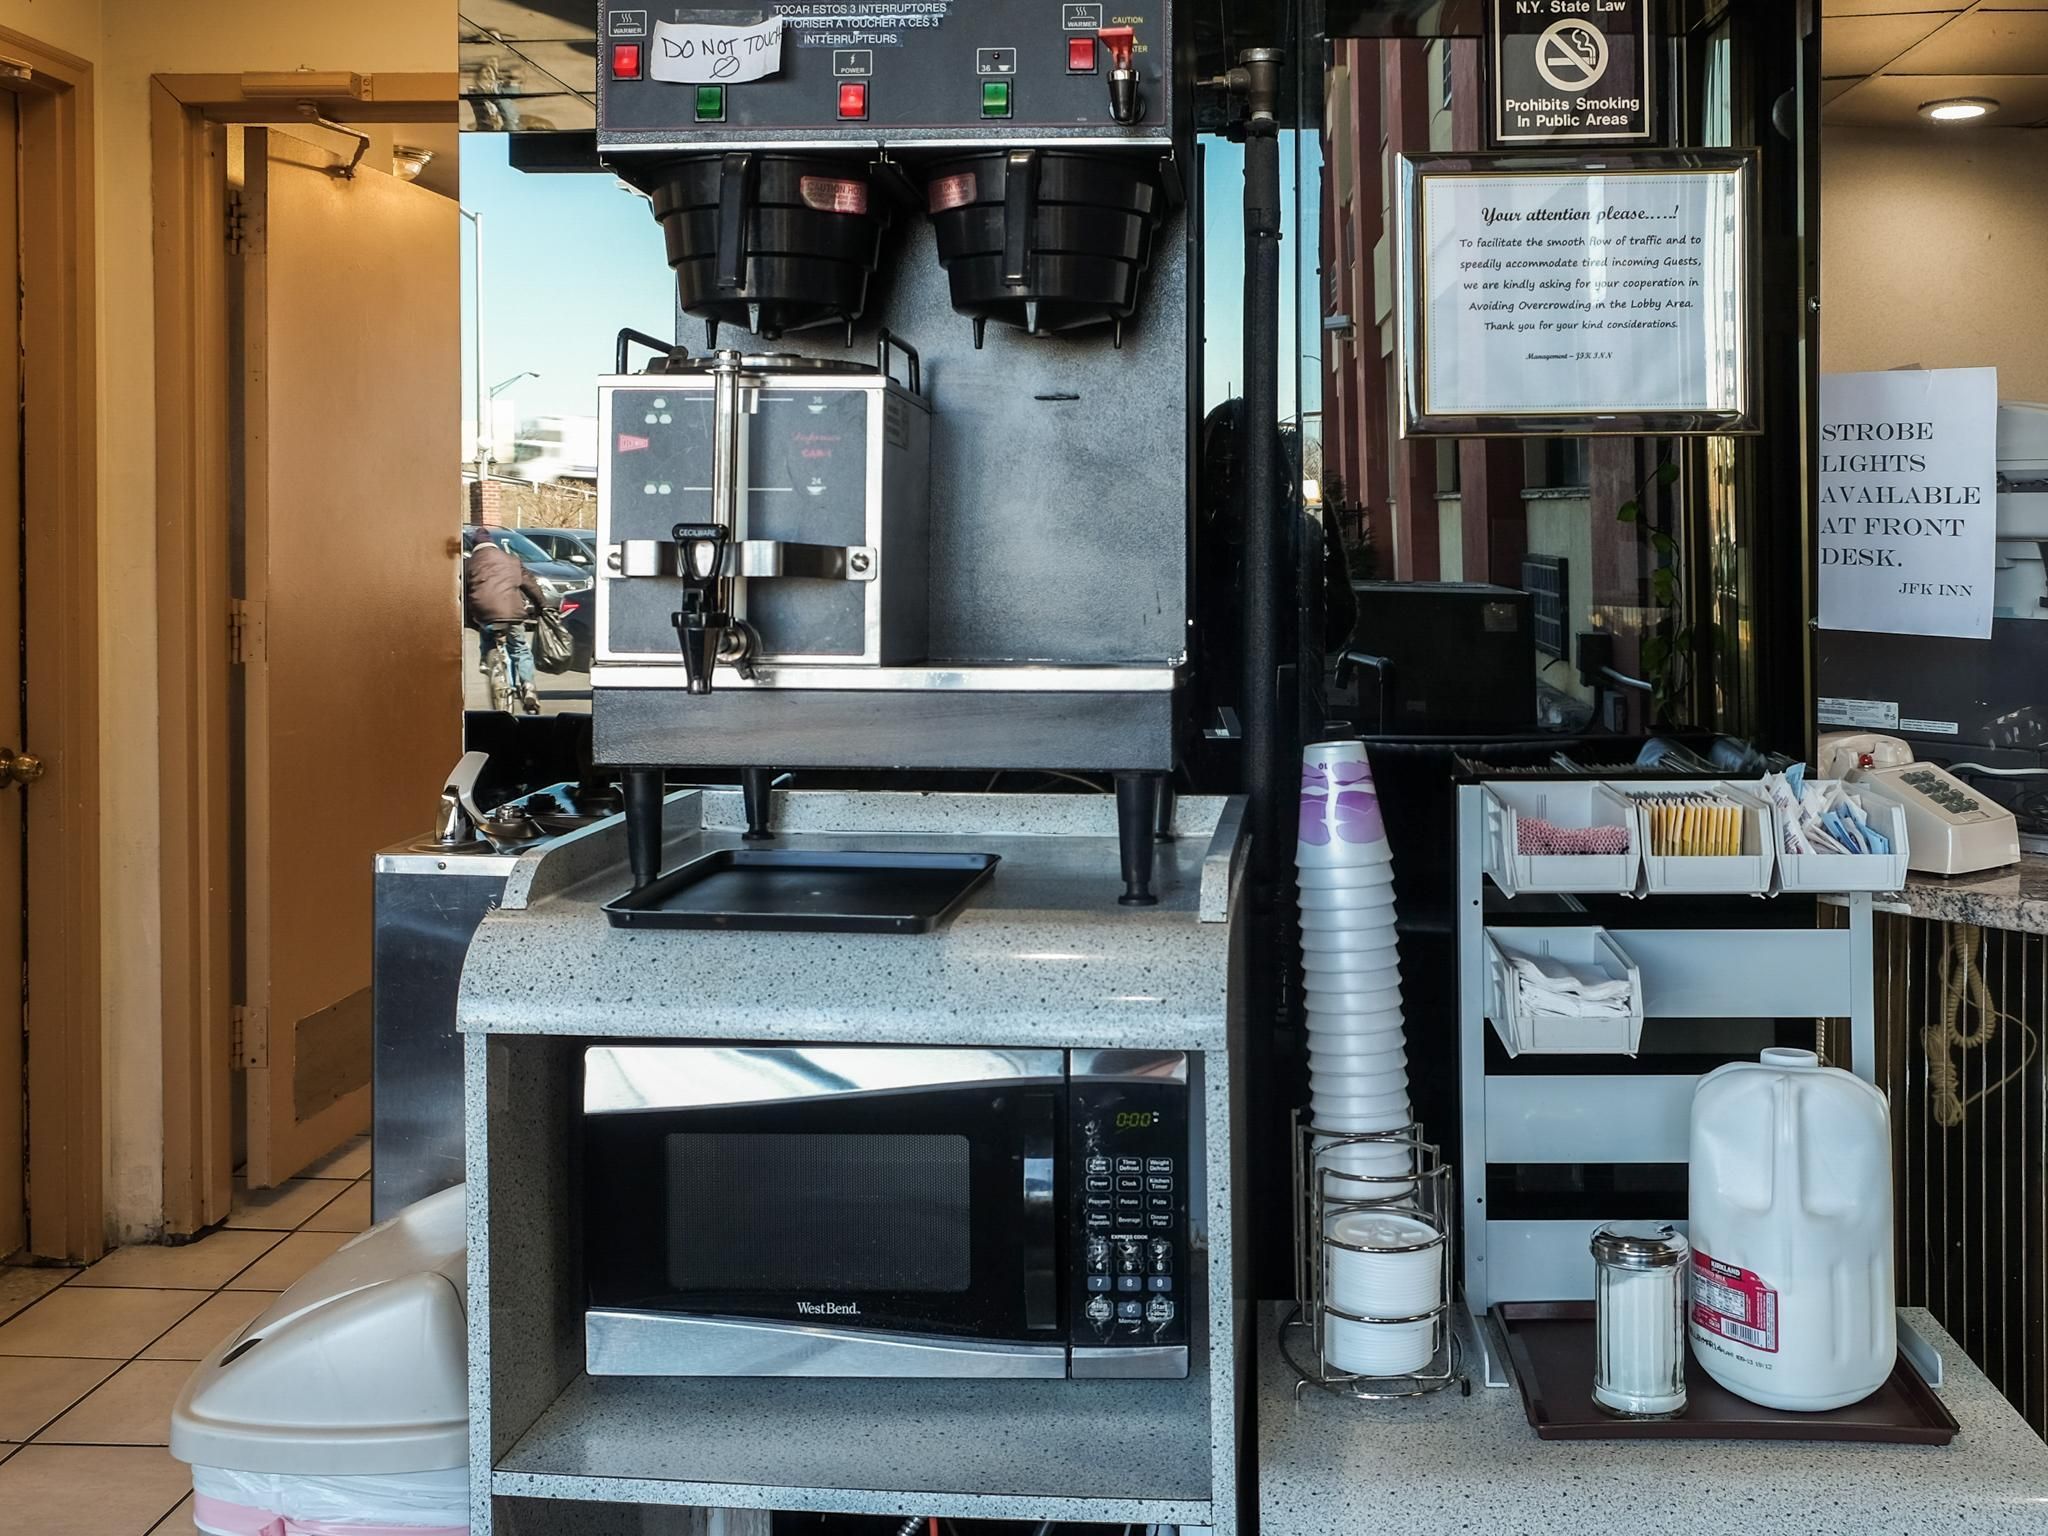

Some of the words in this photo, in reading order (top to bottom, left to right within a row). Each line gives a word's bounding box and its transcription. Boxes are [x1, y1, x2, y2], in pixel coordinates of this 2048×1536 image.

[774, 5, 810, 14] TOCAR
[813, 4, 847, 14] ESTOS
[850, 4, 856, 13] 3
[859, 3, 947, 13] INTERRUPTORES
[1516, 1, 1544, 14] N.Y.
[1550, 0, 1590, 13] State
[1597, 0, 1626, 11] Law
[836, 19, 844, 28] A
[848, 18, 896, 28] TOUCHER
[899, 18, 906, 27] A
[908, 17, 930, 27] CES
[932, 17, 938, 27] 3
[661, 37, 695, 58] DO
[701, 38, 739, 55] NOT
[743, 26, 782, 55] TOUCH
[1506, 99, 1570, 112] Prohibits
[1576, 97, 1640, 111] Smoking
[1517, 115, 1530, 127] In
[1536, 114, 1580, 127] Public
[1586, 113, 1628, 125] Areas
[1481, 207, 1521, 226] Your
[1526, 207, 1590, 221] attention
[1459, 239, 1473, 248] To
[1477, 237, 1522, 247] facilitate
[1526, 237, 1543, 246] the
[1547, 236, 1585, 247] smooth
[1589, 236, 1612, 246] flow
[1616, 235, 1627, 245] of
[1630, 235, 1662, 245] traffic
[1666, 234, 1686, 245] and
[1691, 235, 1702, 244] to
[1460, 258, 1502, 272] speedily
[1506, 258, 1578, 268] accommodate
[1583, 257, 1608, 267] tired
[1612, 256, 1660, 269] incoming
[1664, 256, 1702, 267] Guests,
[1464, 282, 1478, 290] we
[1482, 281, 1499, 289] are
[1503, 279, 1535, 291] kindly
[1540, 279, 1572, 291] asking
[1575, 278, 1591, 289] for
[1595, 280, 1620, 291] your
[1623, 277, 1685, 290] cooperation
[1689, 277, 1699, 286] in
[1469, 301, 1514, 313] Avoiding
[1519, 300, 1591, 312] Overcrowding
[1596, 299, 1605, 309] in
[1610, 299, 1627, 309] the
[1631, 298, 1661, 311] Lobby
[1666, 299, 1694, 309] Area.
[1485, 321, 1514, 330] Thank
[1519, 323, 1535, 332] you
[1540, 320, 1553, 329] for
[1557, 322, 1579, 332] your
[1582, 320, 1603, 329] kind
[1607, 319, 1678, 329] considerations.
[1526, 353, 1568, 361] Management
[1822, 422, 1933, 441] STROBE
[1821, 455, 1926, 472] LIGHTS
[1821, 486, 1981, 504] AVAILABLE
[679, 529, 716, 537] CECILWARE
[1821, 517, 1856, 534] AT
[1864, 517, 1965, 536] FRONT
[1821, 548, 1902, 567] DESK.
[1899, 582, 1933, 595] JFK
[1939, 583, 1973, 596] INN
[1116, 1112, 1151, 1127] 0:00
[1711, 1260, 1741, 1276] KIRKLAND
[1096, 1278, 1103, 1287] 7
[1126, 1278, 1133, 1287] 8
[1156, 1278, 1163, 1288] 9
[796, 1301, 825, 1315] West
